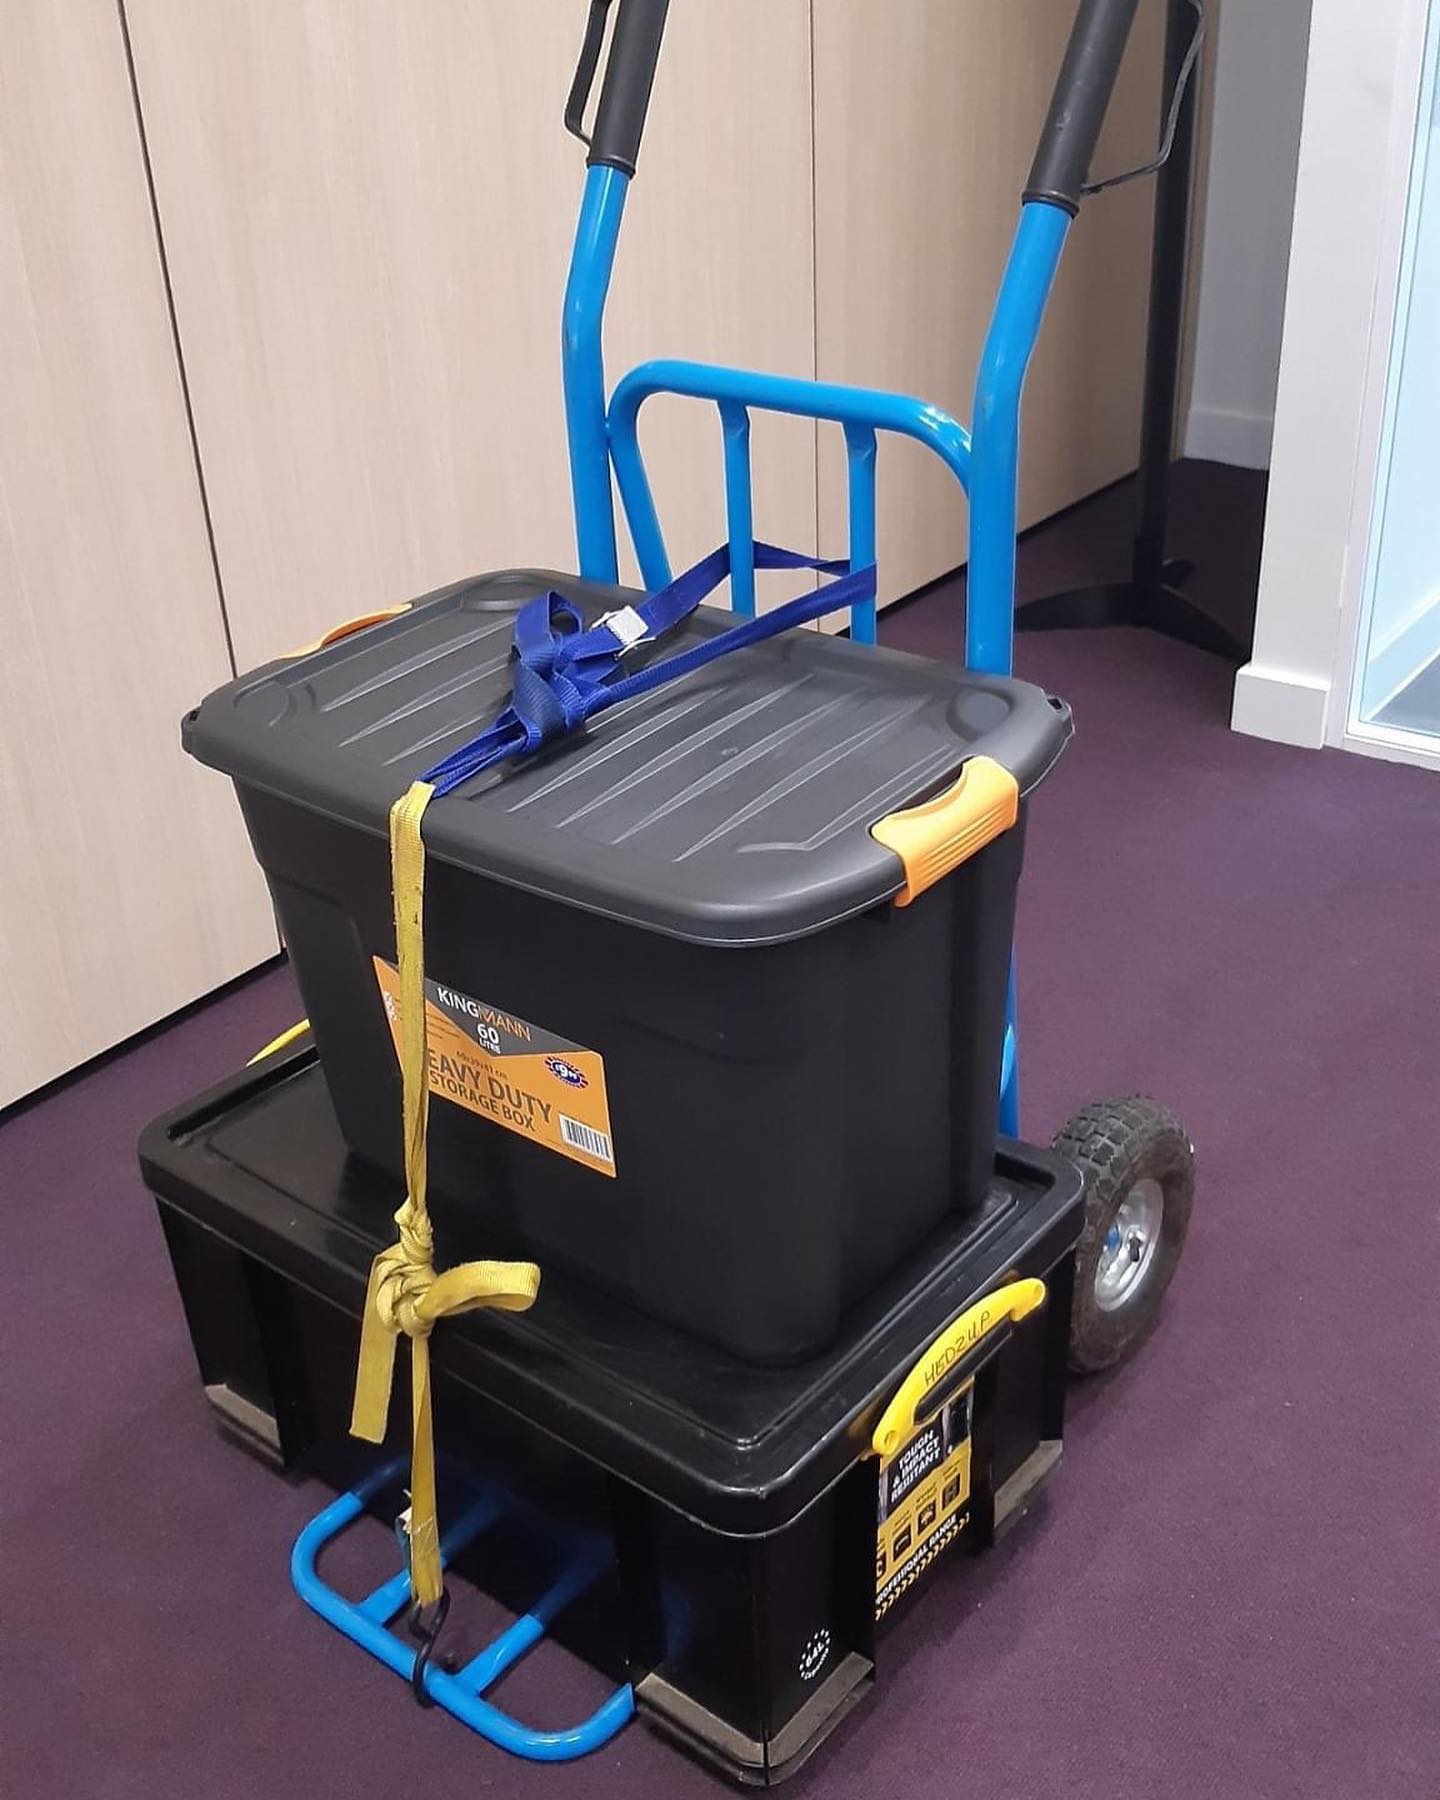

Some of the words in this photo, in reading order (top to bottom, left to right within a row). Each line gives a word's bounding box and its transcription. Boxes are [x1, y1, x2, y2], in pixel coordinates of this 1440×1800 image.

[437, 986, 531, 1042] KINGMANN
[477, 1023, 500, 1045] 60
[427, 1048, 481, 1090] EAVY
[487, 1075, 552, 1124] DUTY
[429, 1070, 499, 1115] STORAGE
[501, 1103, 536, 1132] BOX
[890, 1446, 941, 1504] RESISTANT
[899, 1429, 935, 1470] TOUGH
[901, 1435, 940, 1480] IMPACT
